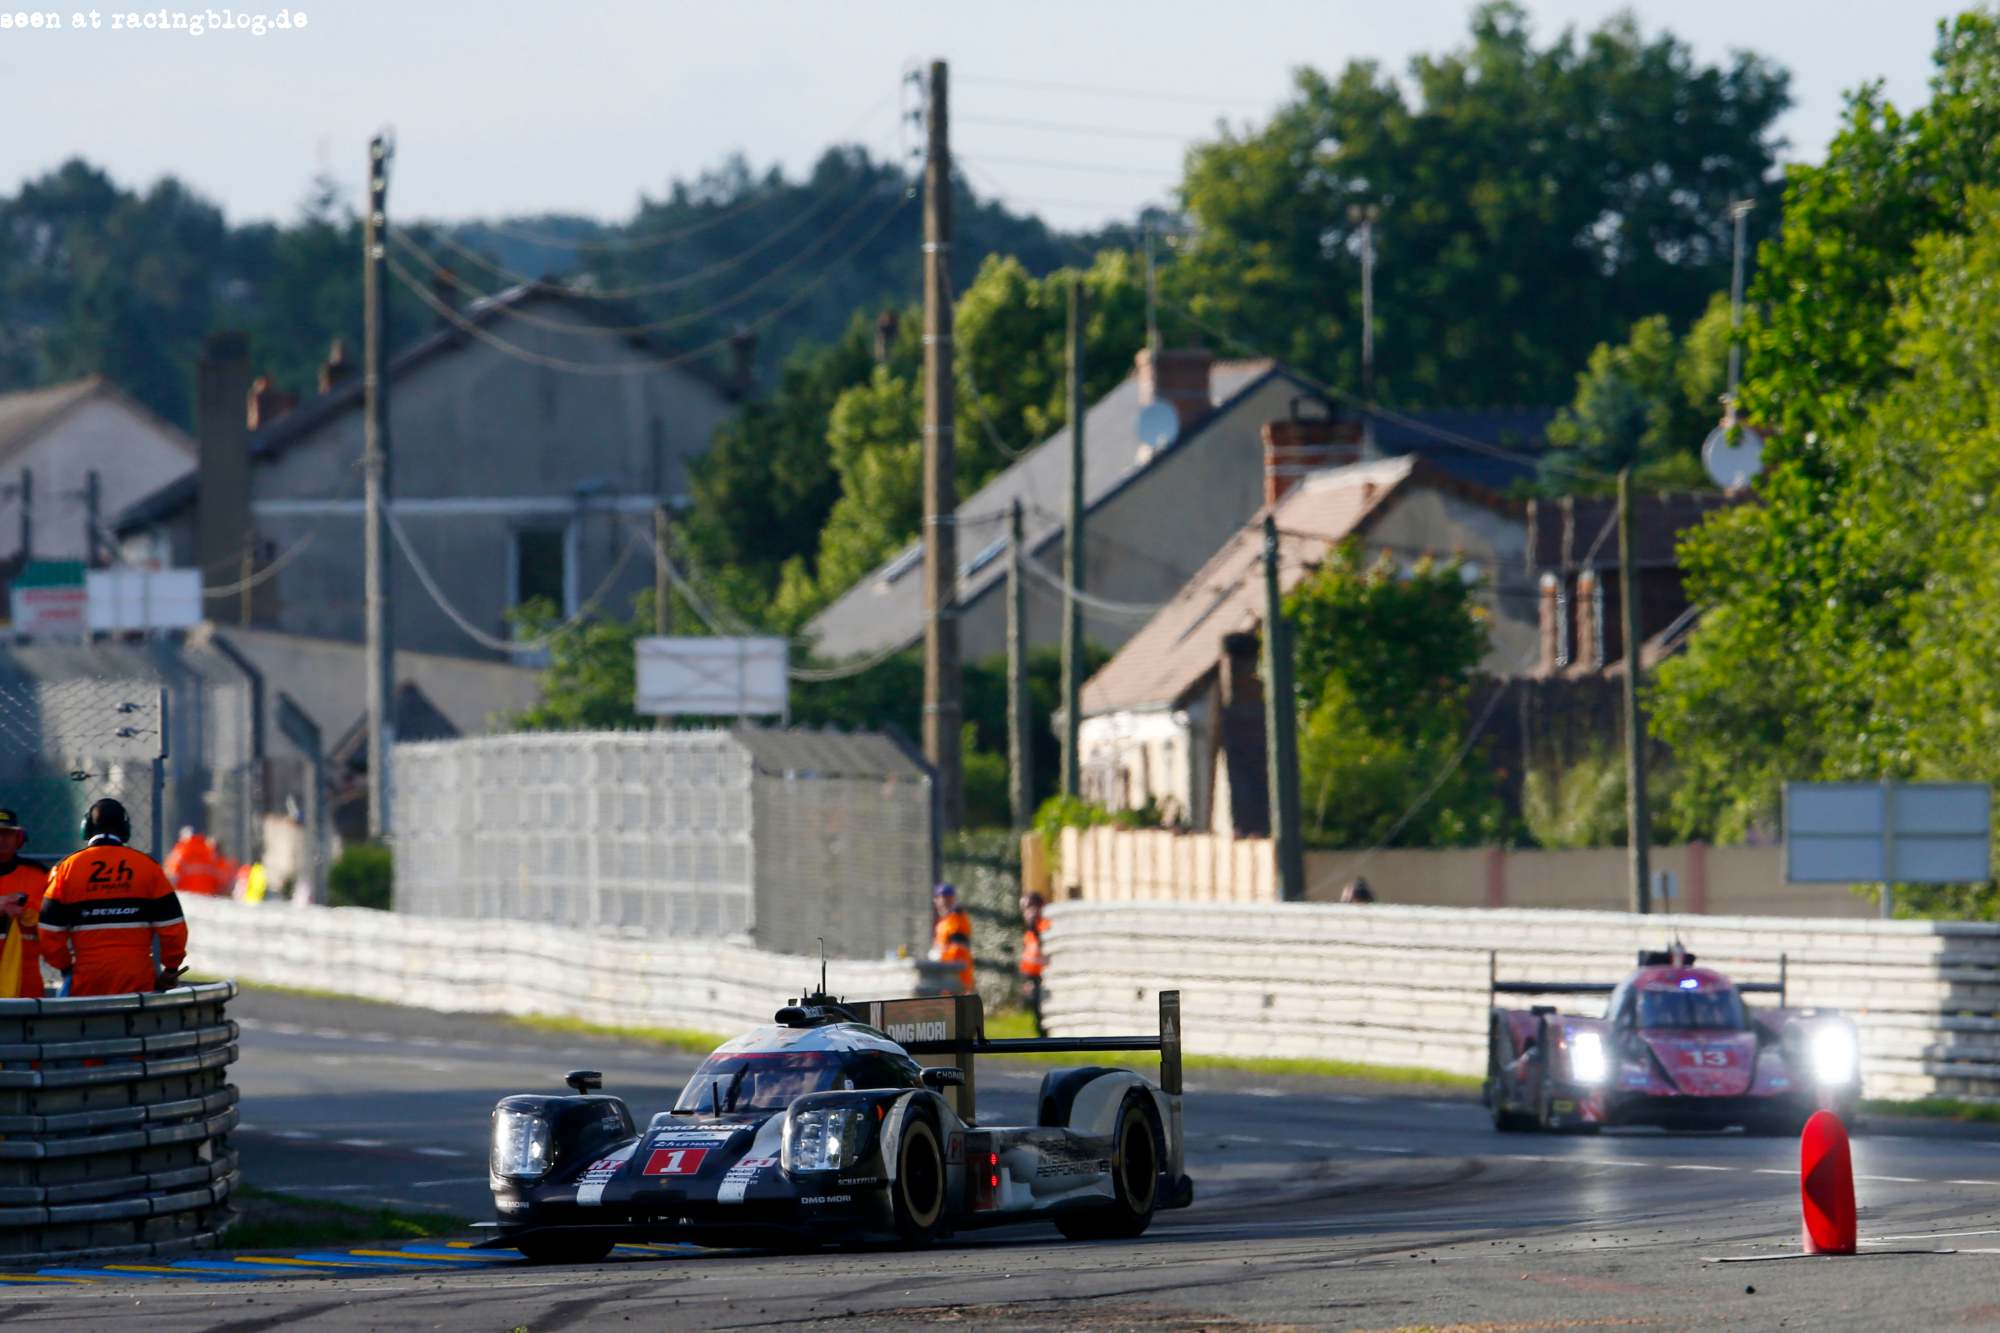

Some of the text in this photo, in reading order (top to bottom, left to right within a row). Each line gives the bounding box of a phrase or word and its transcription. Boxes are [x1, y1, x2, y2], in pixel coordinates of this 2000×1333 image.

[92, 907, 140, 916] DUNLOP
[886, 1021, 946, 1043] DMG MORI
[1688, 1051, 1728, 1066] 13
[660, 1150, 687, 1173] 1
[826, 1195, 851, 1203] MORI
